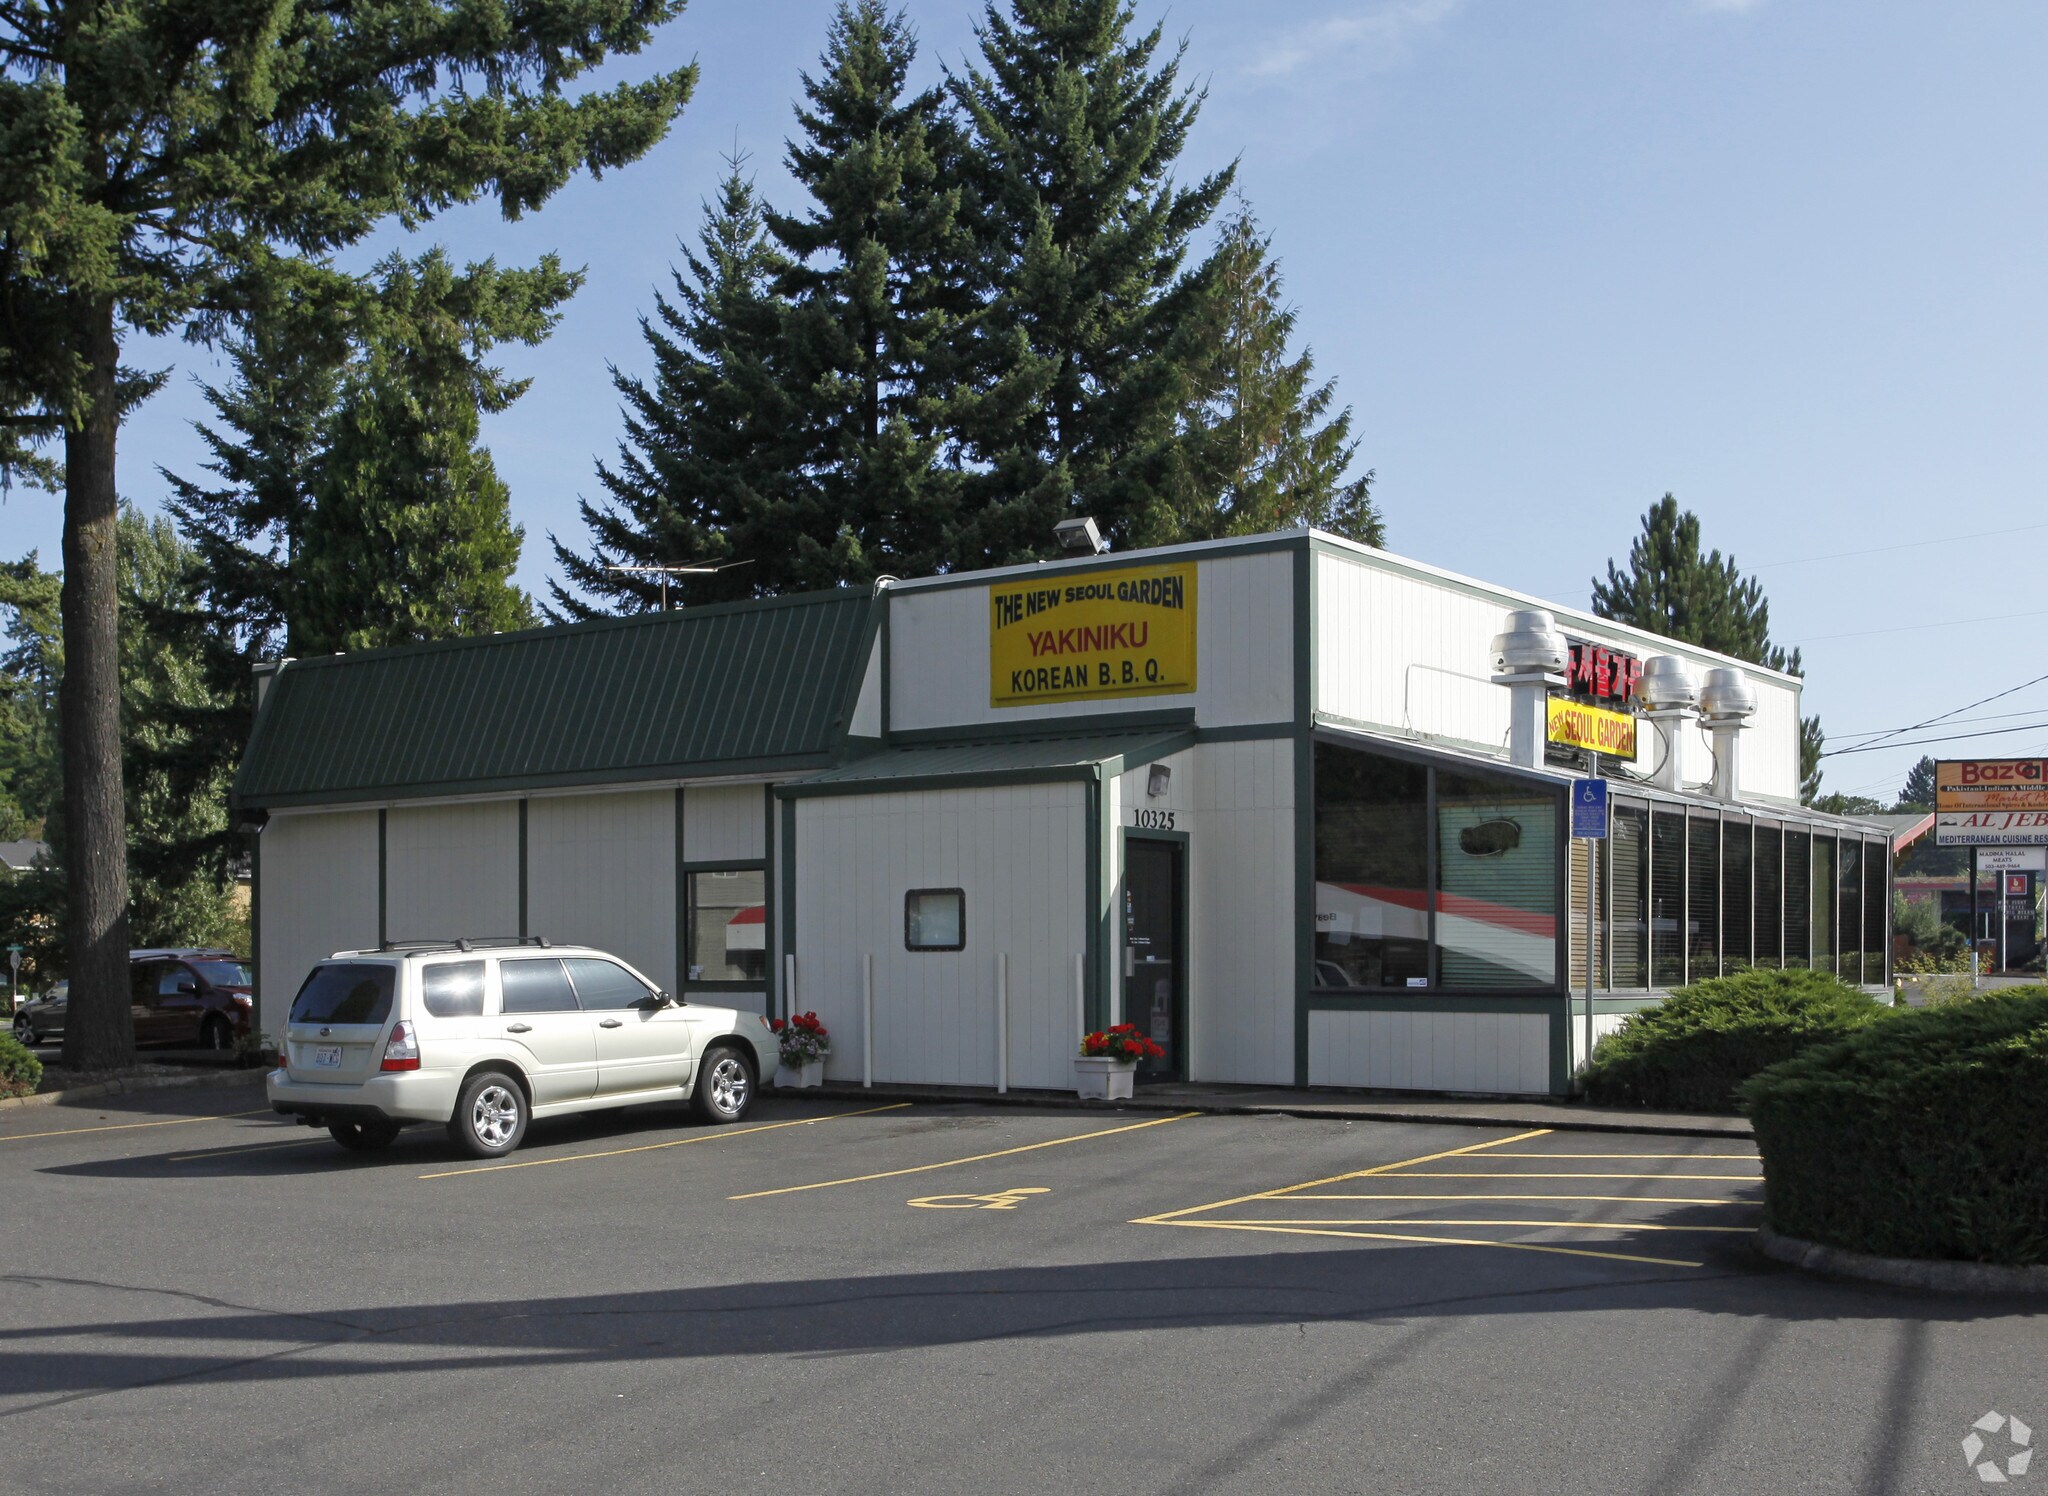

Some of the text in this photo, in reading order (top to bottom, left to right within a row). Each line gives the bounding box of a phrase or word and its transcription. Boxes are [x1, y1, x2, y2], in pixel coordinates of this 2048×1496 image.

[995, 575, 1184, 629] THE NEW SEOUL GARDEN
[1027, 621, 1148, 657] YAKINIKU
[1012, 664, 1088, 693] KOREAN
[1549, 709, 1634, 752] NEW SEOUL GARDEN
[1134, 808, 1175, 830] 10325
[1960, 814, 1996, 827] AL
[1939, 834, 2000, 844] MEDITERRANEAN
[2002, 834, 2032, 843] CUISINE
